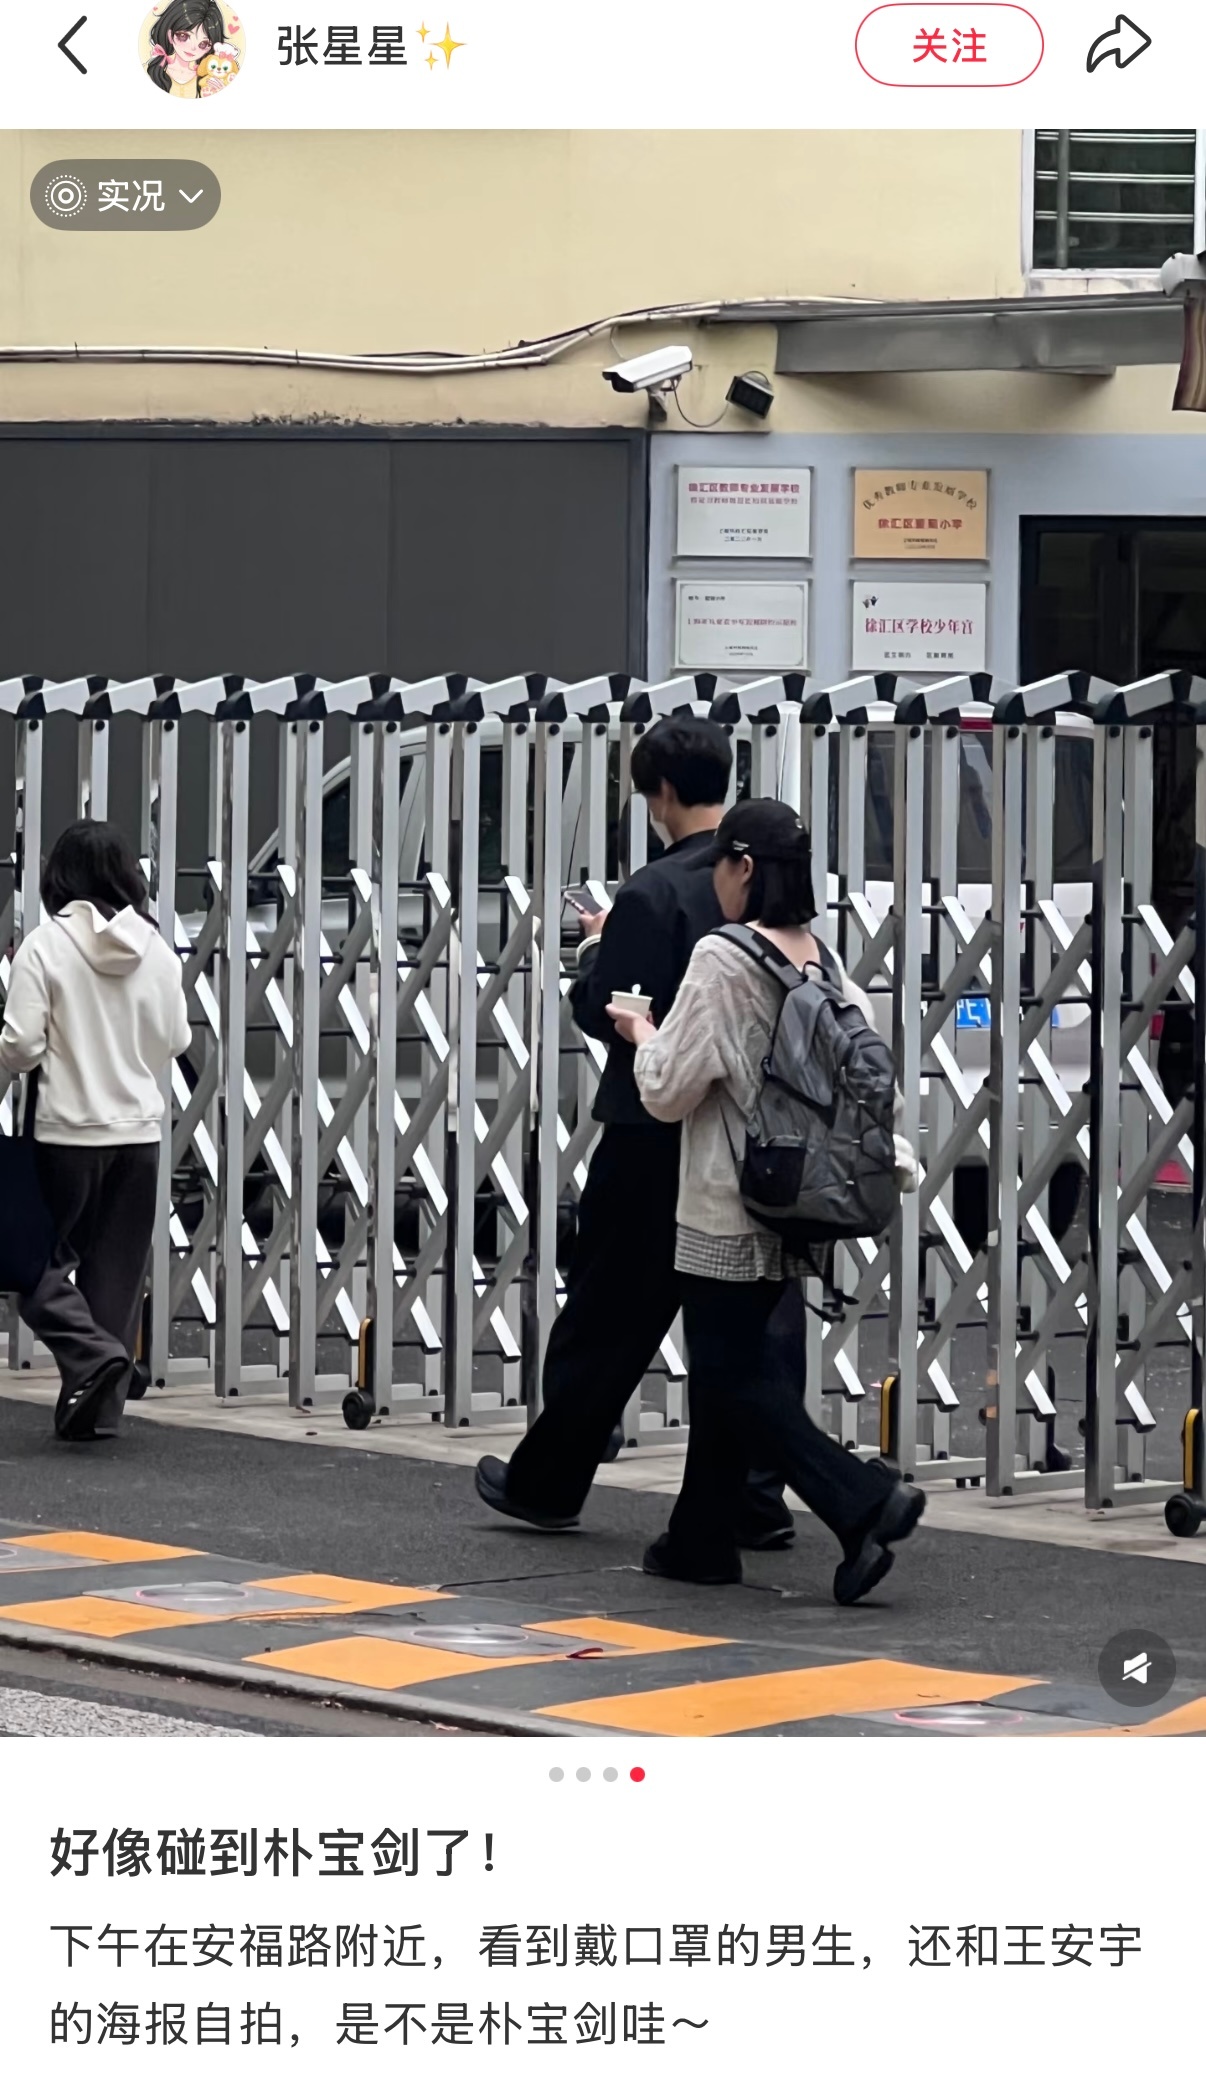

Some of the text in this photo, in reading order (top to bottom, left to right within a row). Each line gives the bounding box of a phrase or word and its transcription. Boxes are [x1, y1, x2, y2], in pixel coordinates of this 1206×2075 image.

[865, 617, 973, 635] 徐汇区学校少年宫
